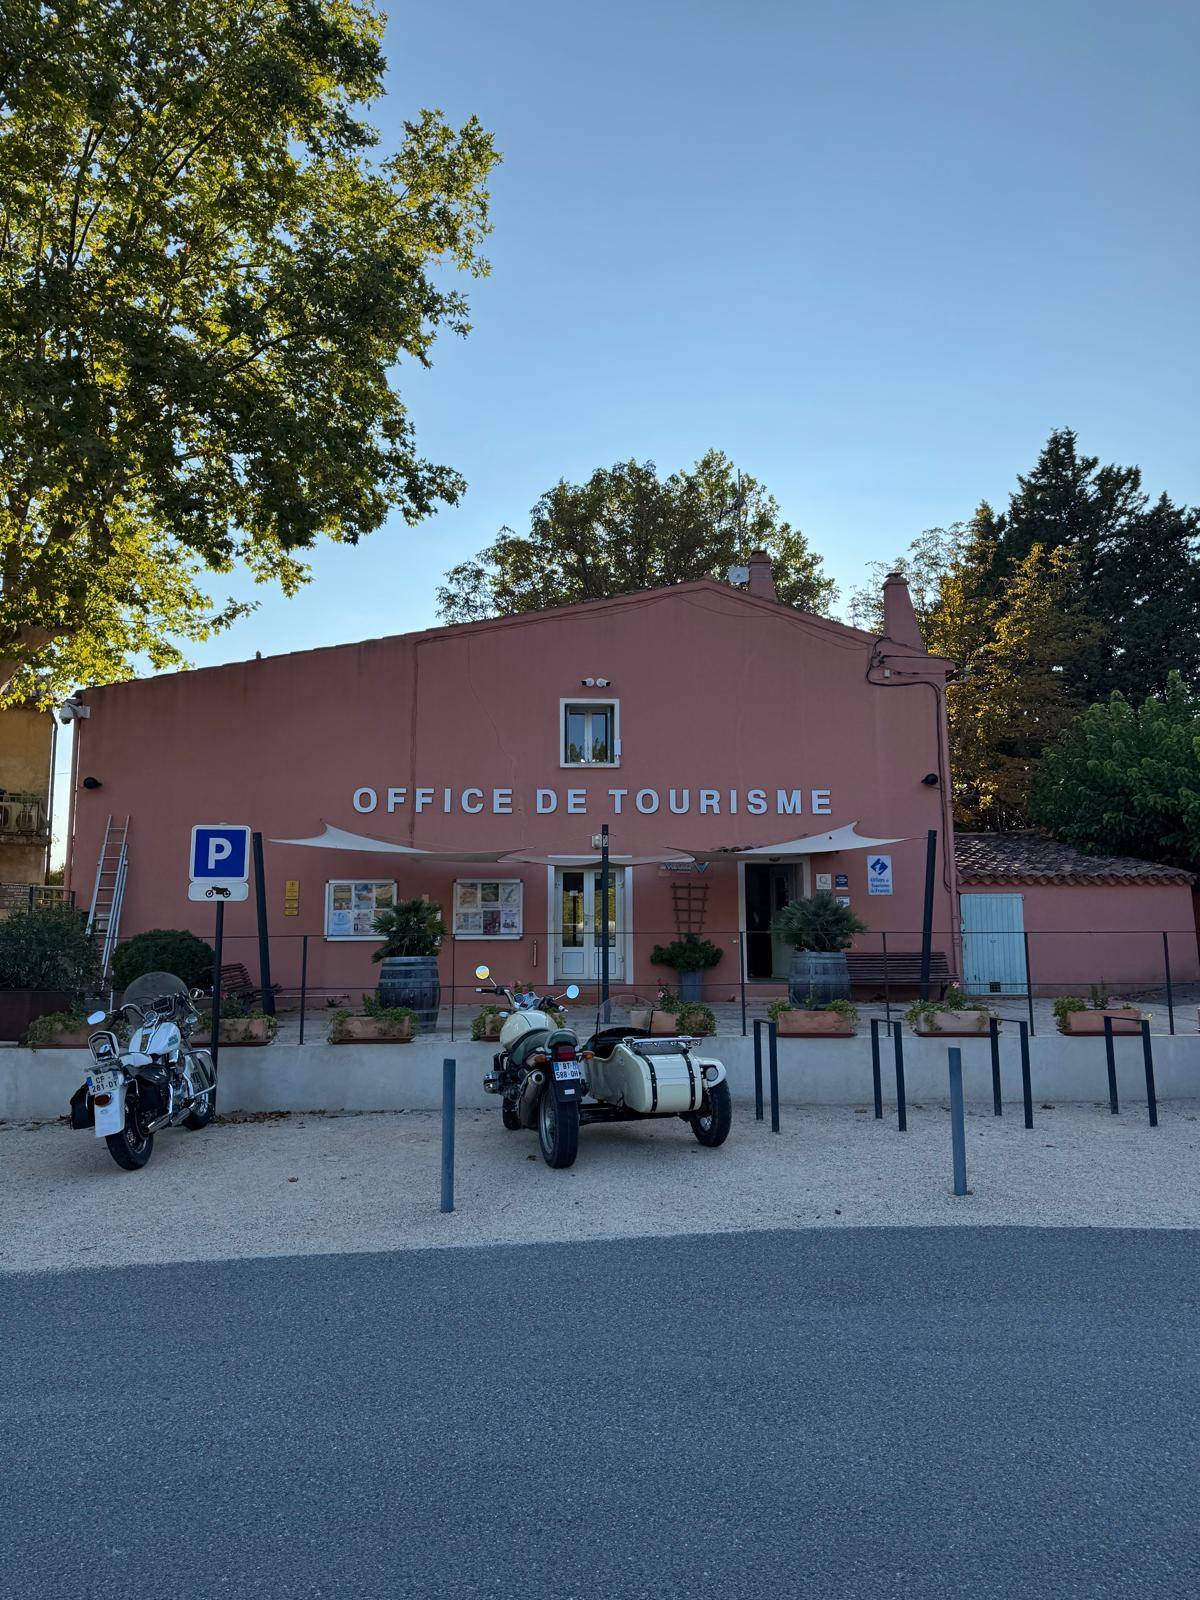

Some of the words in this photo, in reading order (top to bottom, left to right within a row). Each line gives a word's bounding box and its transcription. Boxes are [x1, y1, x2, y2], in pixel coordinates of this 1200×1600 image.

[352, 787, 513, 814] OFFICE
[536, 788, 587, 814] DE
[608, 788, 832, 815] TOURISME
[207, 837, 232, 869] P
